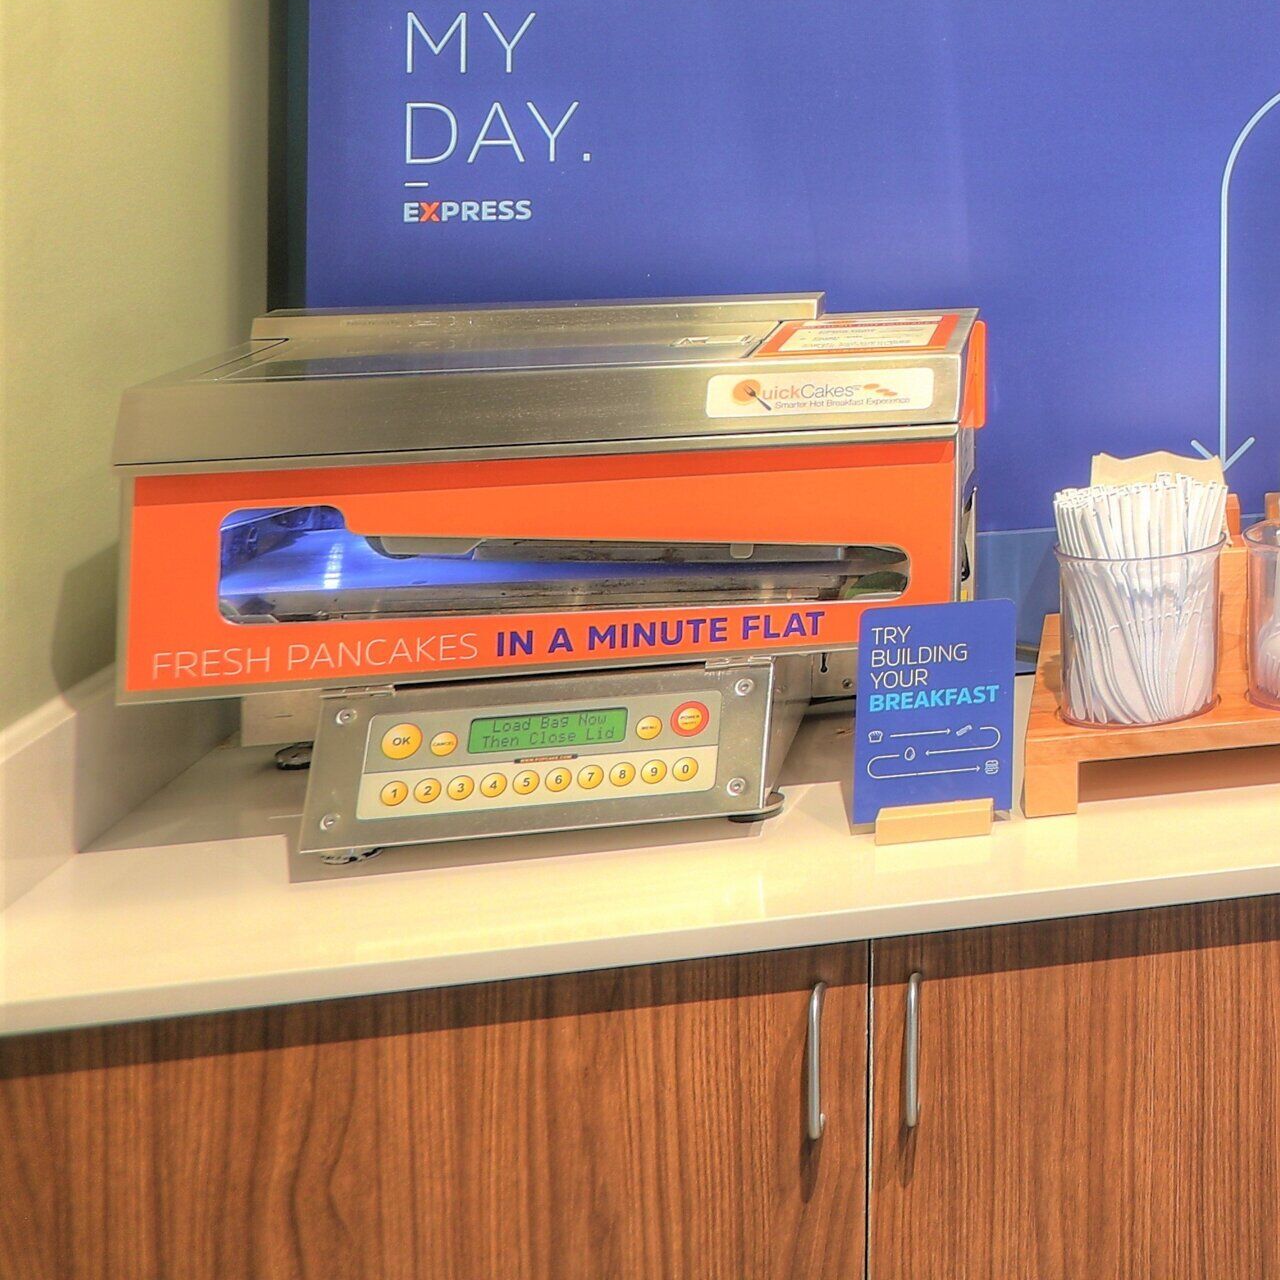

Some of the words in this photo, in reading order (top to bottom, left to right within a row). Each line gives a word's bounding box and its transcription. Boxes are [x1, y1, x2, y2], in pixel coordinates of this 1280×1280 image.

[404, 11, 537, 73] MY
[405, 101, 592, 164] DAY.
[403, 200, 532, 223] EXPRESS
[775, 400, 809, 410] Smarter
[809, 399, 825, 408] Hot
[826, 397, 865, 407] Breakfast
[152, 646, 271, 680] FRESH
[287, 633, 479, 671] PANCAKES
[496, 630, 534, 658] IN
[547, 627, 574, 654] A
[588, 617, 728, 651] MINUTE
[741, 611, 826, 640] FLAT
[871, 625, 911, 645] TRY
[871, 643, 968, 668] BUILDING
[870, 668, 928, 690] YOUR
[869, 685, 1000, 712] BREAKFAST
[492, 718, 530, 733] Load
[540, 716, 569, 729] Bag
[577, 713, 607, 725] Now
[392, 736, 411, 746] OK
[482, 733, 519, 749] Then
[529, 730, 576, 746] Close
[585, 726, 614, 741] Lid
[391, 789, 398, 798] 1
[424, 785, 432, 796] 2
[457, 783, 465, 793] 3
[490, 780, 497, 790] 4
[522, 778, 530, 787] 5
[555, 774, 562, 785] 6
[588, 772, 595, 782] 7
[619, 769, 626, 779] 8
[650, 767, 658, 777] 9
[682, 764, 689, 774] 0
